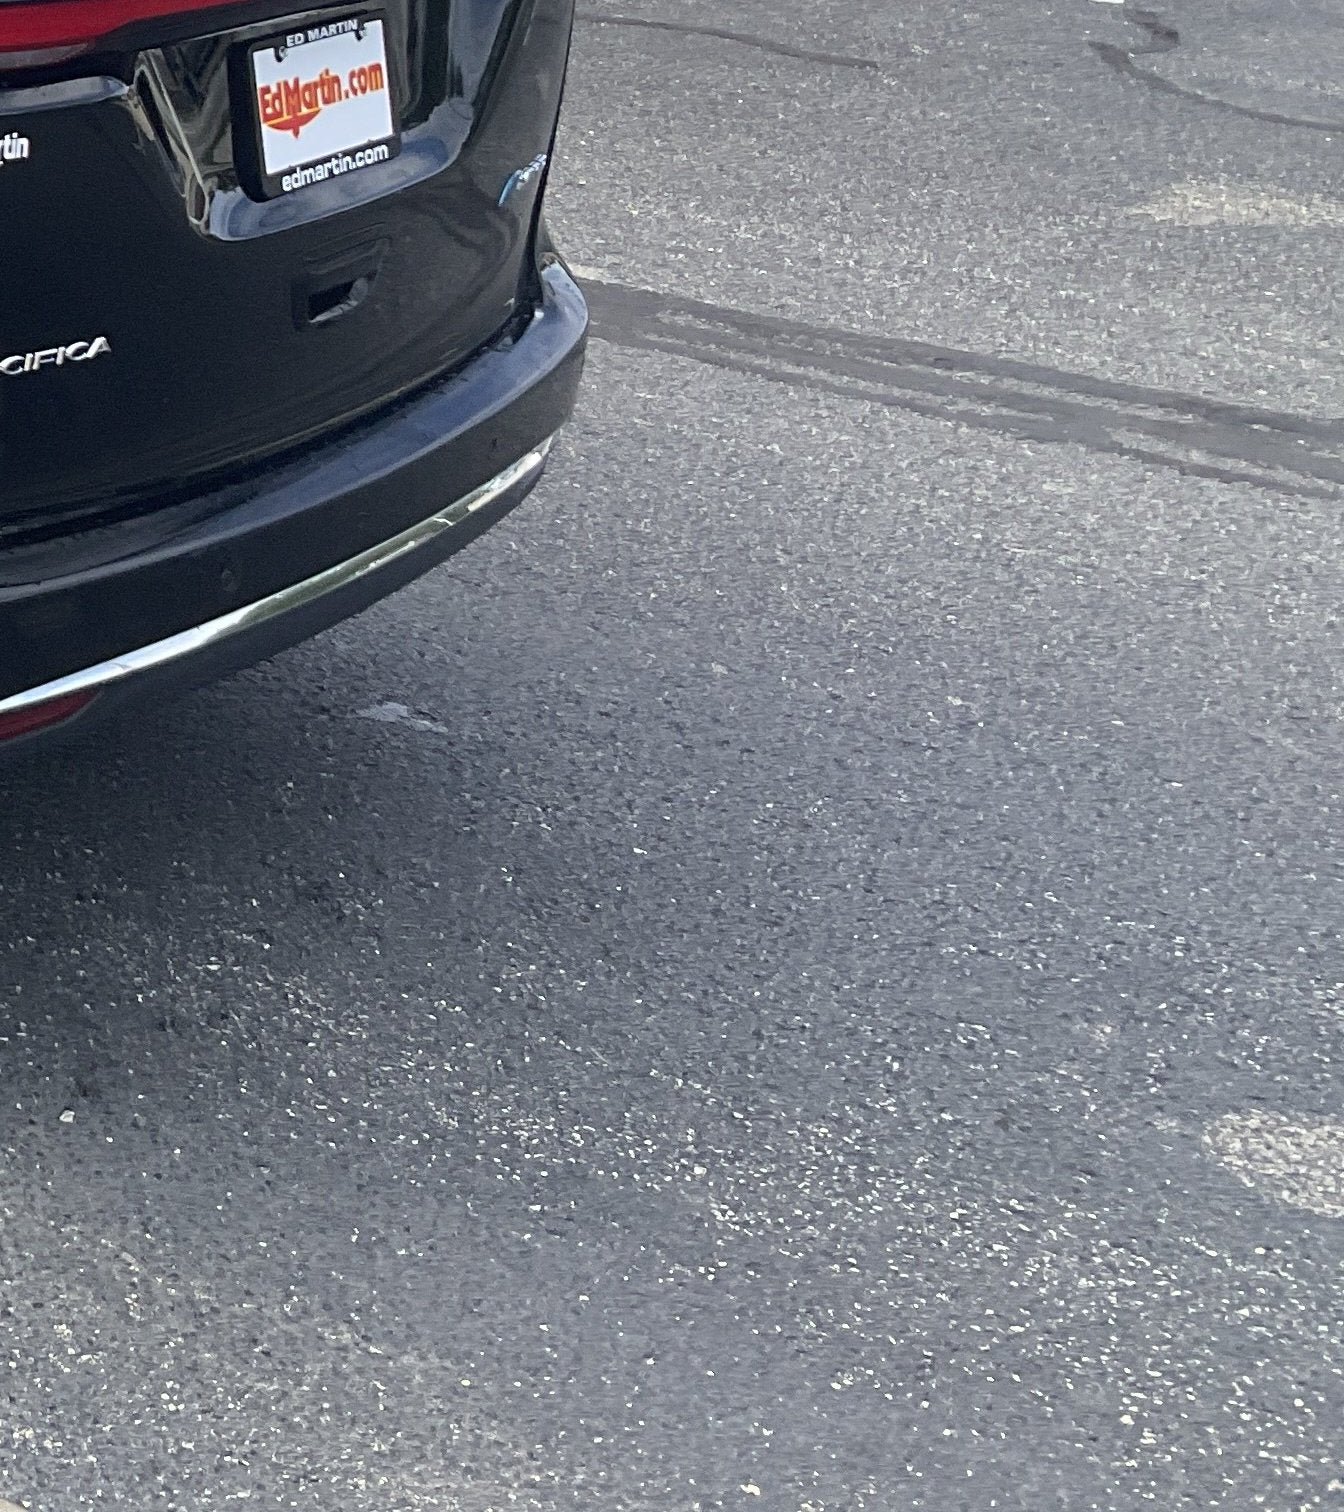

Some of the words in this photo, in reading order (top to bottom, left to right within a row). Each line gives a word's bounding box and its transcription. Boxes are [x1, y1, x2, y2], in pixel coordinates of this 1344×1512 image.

[286, 33, 304, 48] ED
[307, 19, 358, 41] MARTIN
[258, 62, 385, 124] EdMartin.com
[281, 144, 390, 191] edmartin.com
